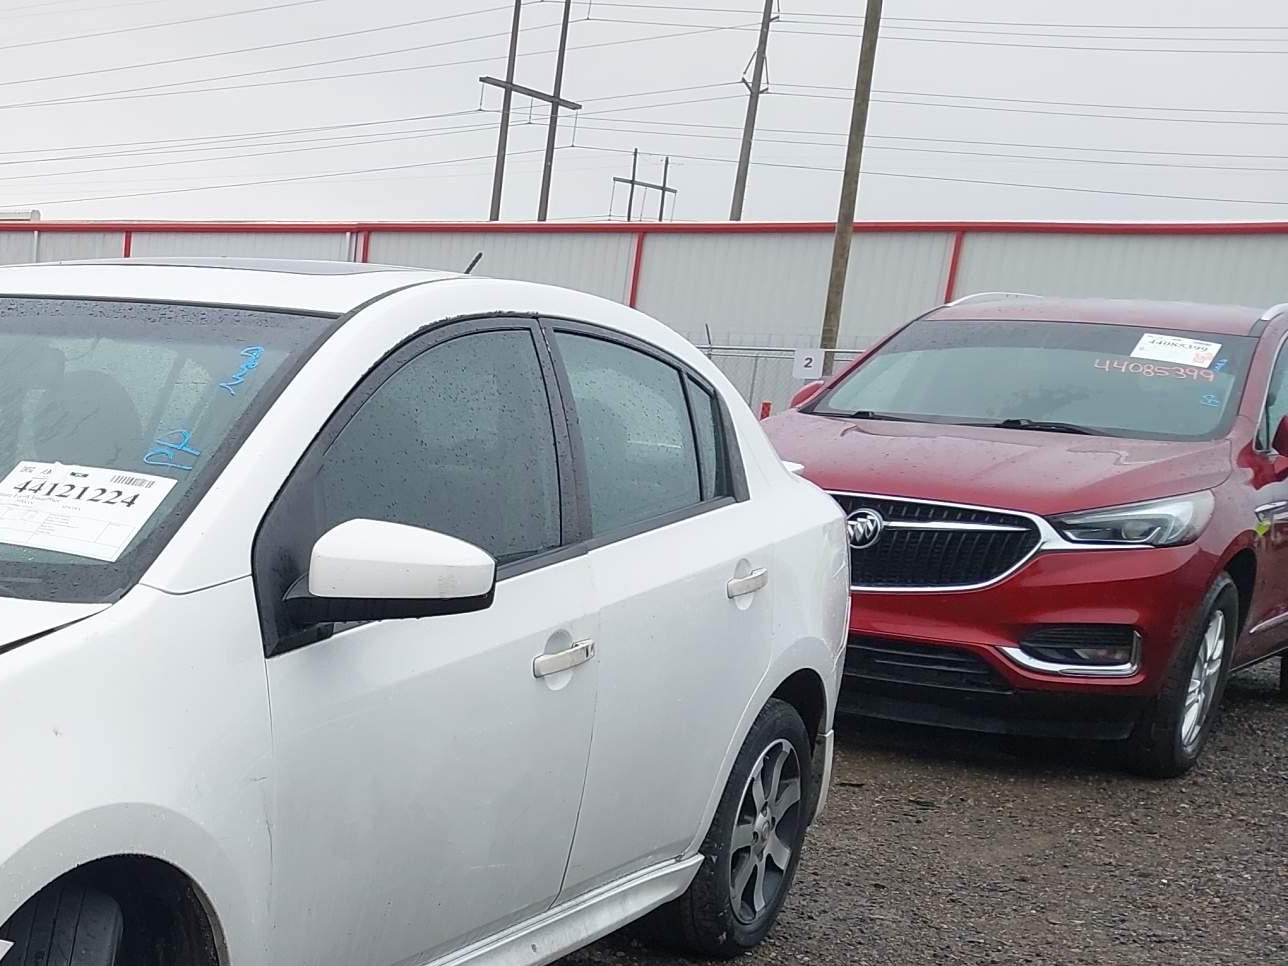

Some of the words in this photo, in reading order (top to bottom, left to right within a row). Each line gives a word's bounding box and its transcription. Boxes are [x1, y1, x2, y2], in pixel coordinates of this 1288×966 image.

[803, 357, 813, 368] 2
[1093, 358, 1216, 382] 44085399
[13, 479, 140, 508] 44121224
